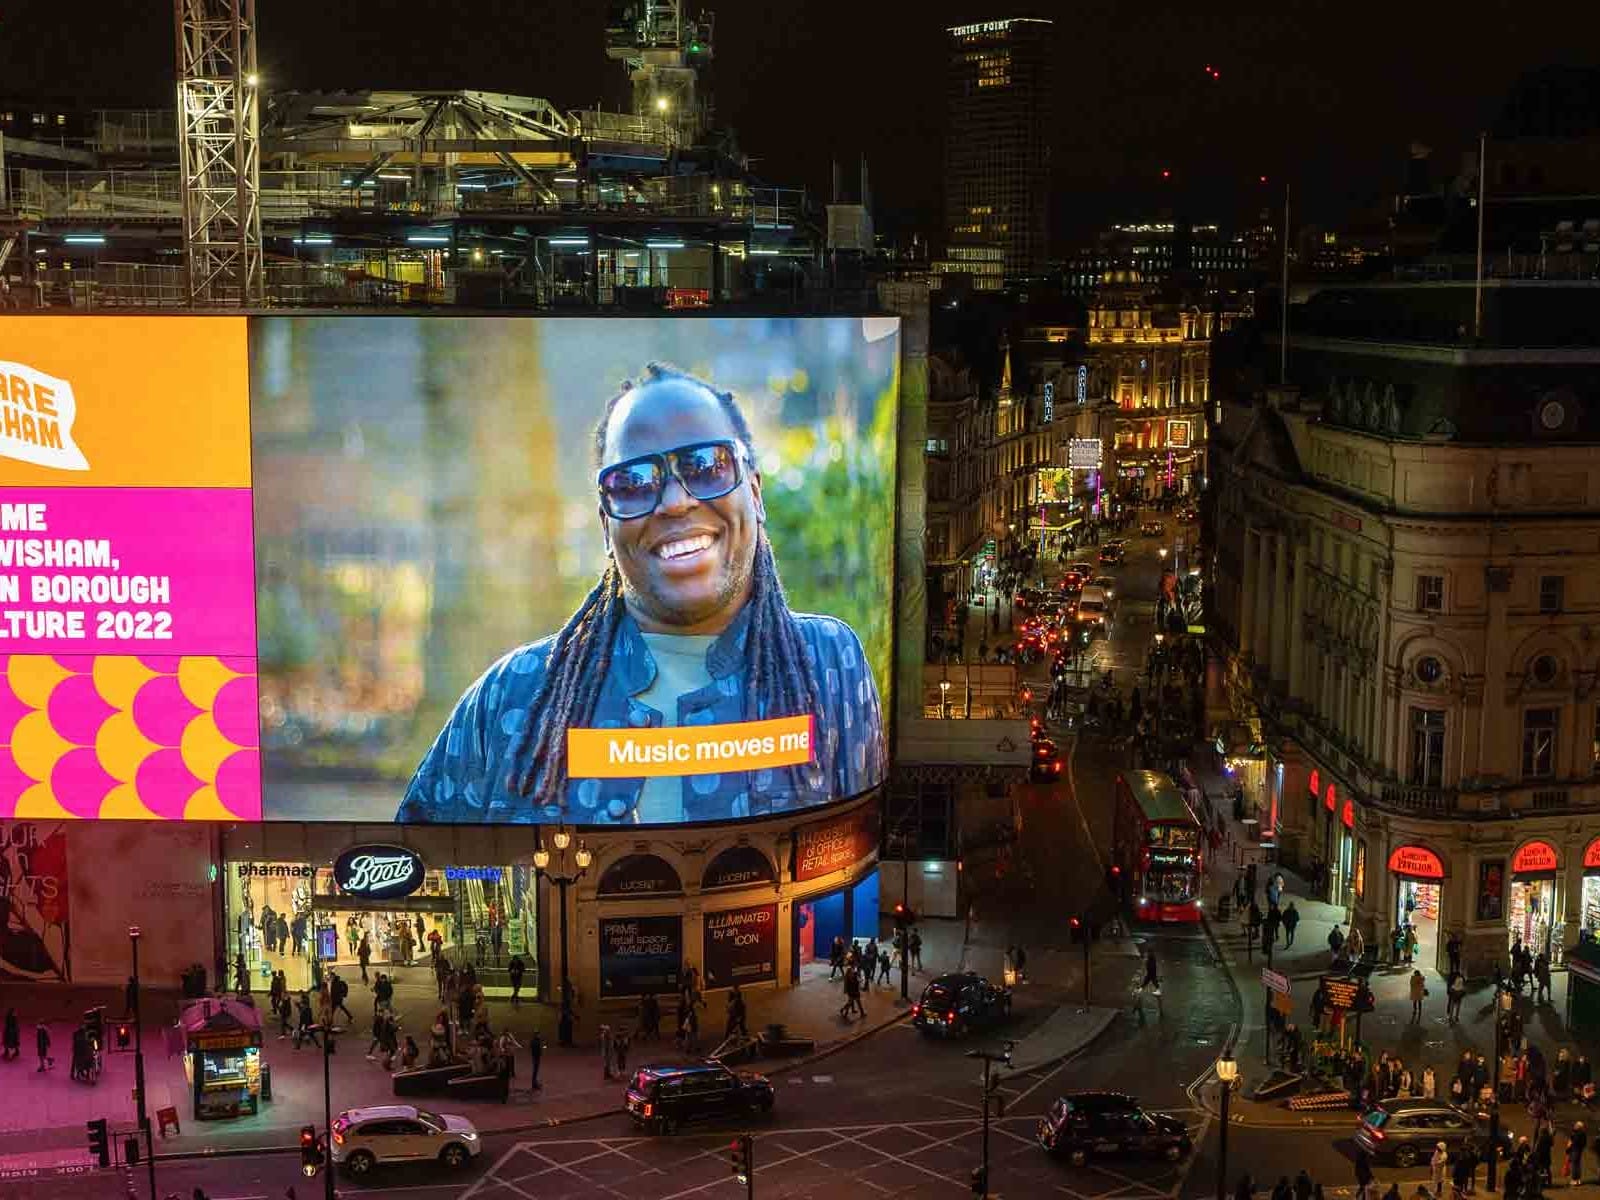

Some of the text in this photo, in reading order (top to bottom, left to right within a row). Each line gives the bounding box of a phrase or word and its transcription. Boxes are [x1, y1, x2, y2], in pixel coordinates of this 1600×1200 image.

[0, 406, 63, 449] HAM
[1, 503, 48, 531] ME
[31, 575, 170, 603] BOROUGH
[96, 610, 172, 639] 2022
[608, 738, 690, 764] Music
[696, 735, 775, 760] moves
[238, 862, 317, 879] pharmacy
[343, 854, 415, 892] Boots
[708, 911, 770, 929] ILLUMINATED
[726, 926, 739, 937] an
[735, 933, 760, 946] ICON
